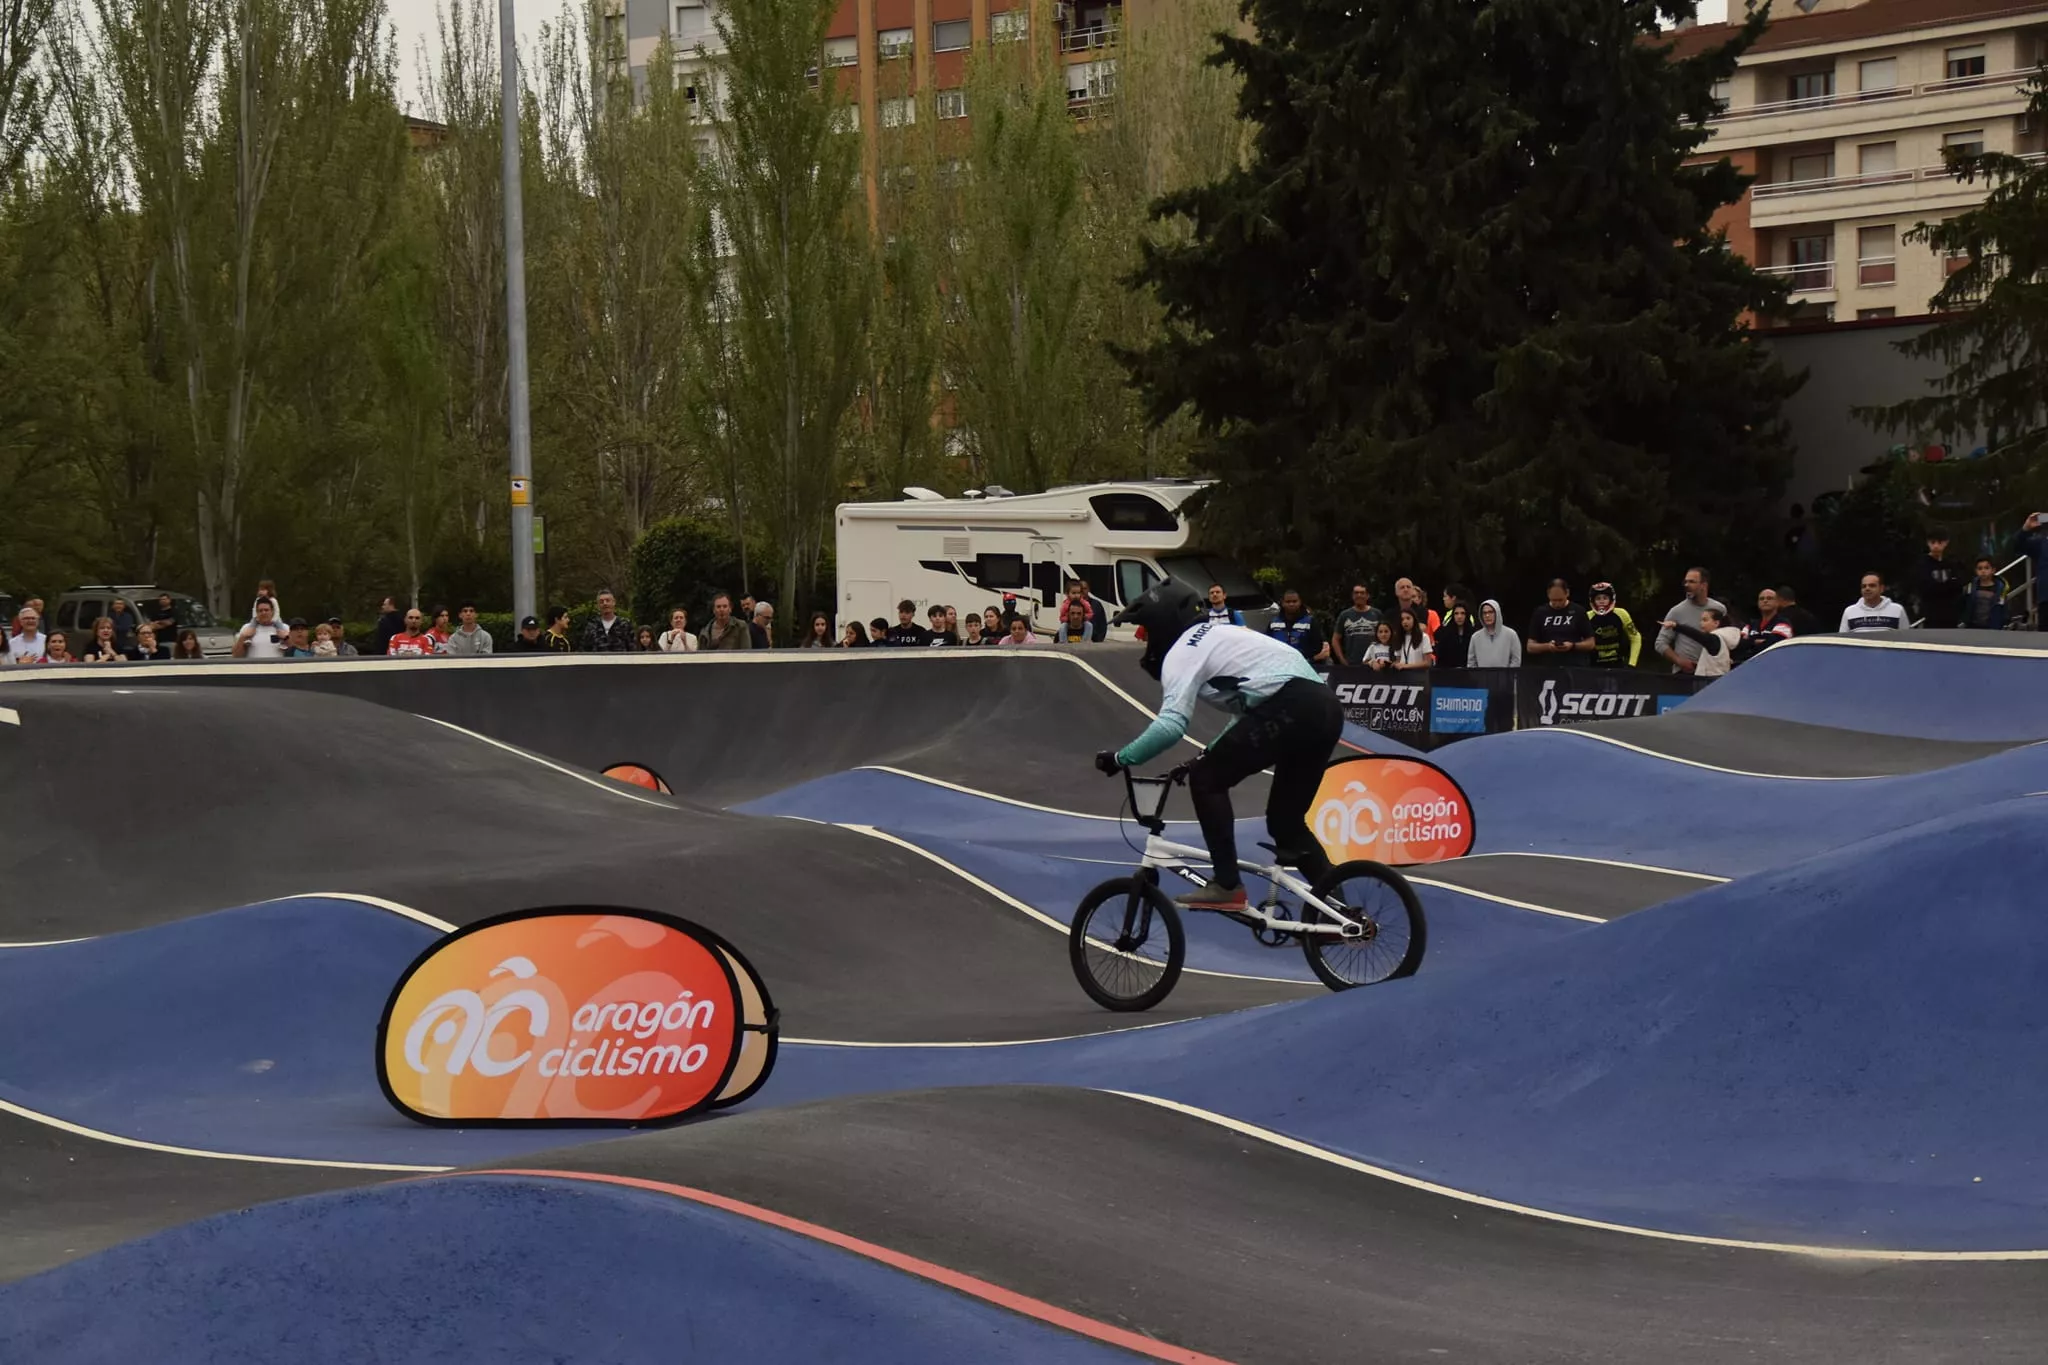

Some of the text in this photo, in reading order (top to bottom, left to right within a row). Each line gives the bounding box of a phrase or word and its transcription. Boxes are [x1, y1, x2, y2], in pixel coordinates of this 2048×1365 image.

[1544, 615, 1573, 626] FOX
[1336, 684, 1424, 706] SCOTT
[1436, 697, 1482, 711] SHIMANO
[1559, 693, 1651, 716] SCOTT
[1392, 797, 1458, 822] aragón
[1384, 822, 1462, 844] ciclismo
[572, 991, 715, 1040] aragón
[538, 1040, 709, 1078] ciclismo
